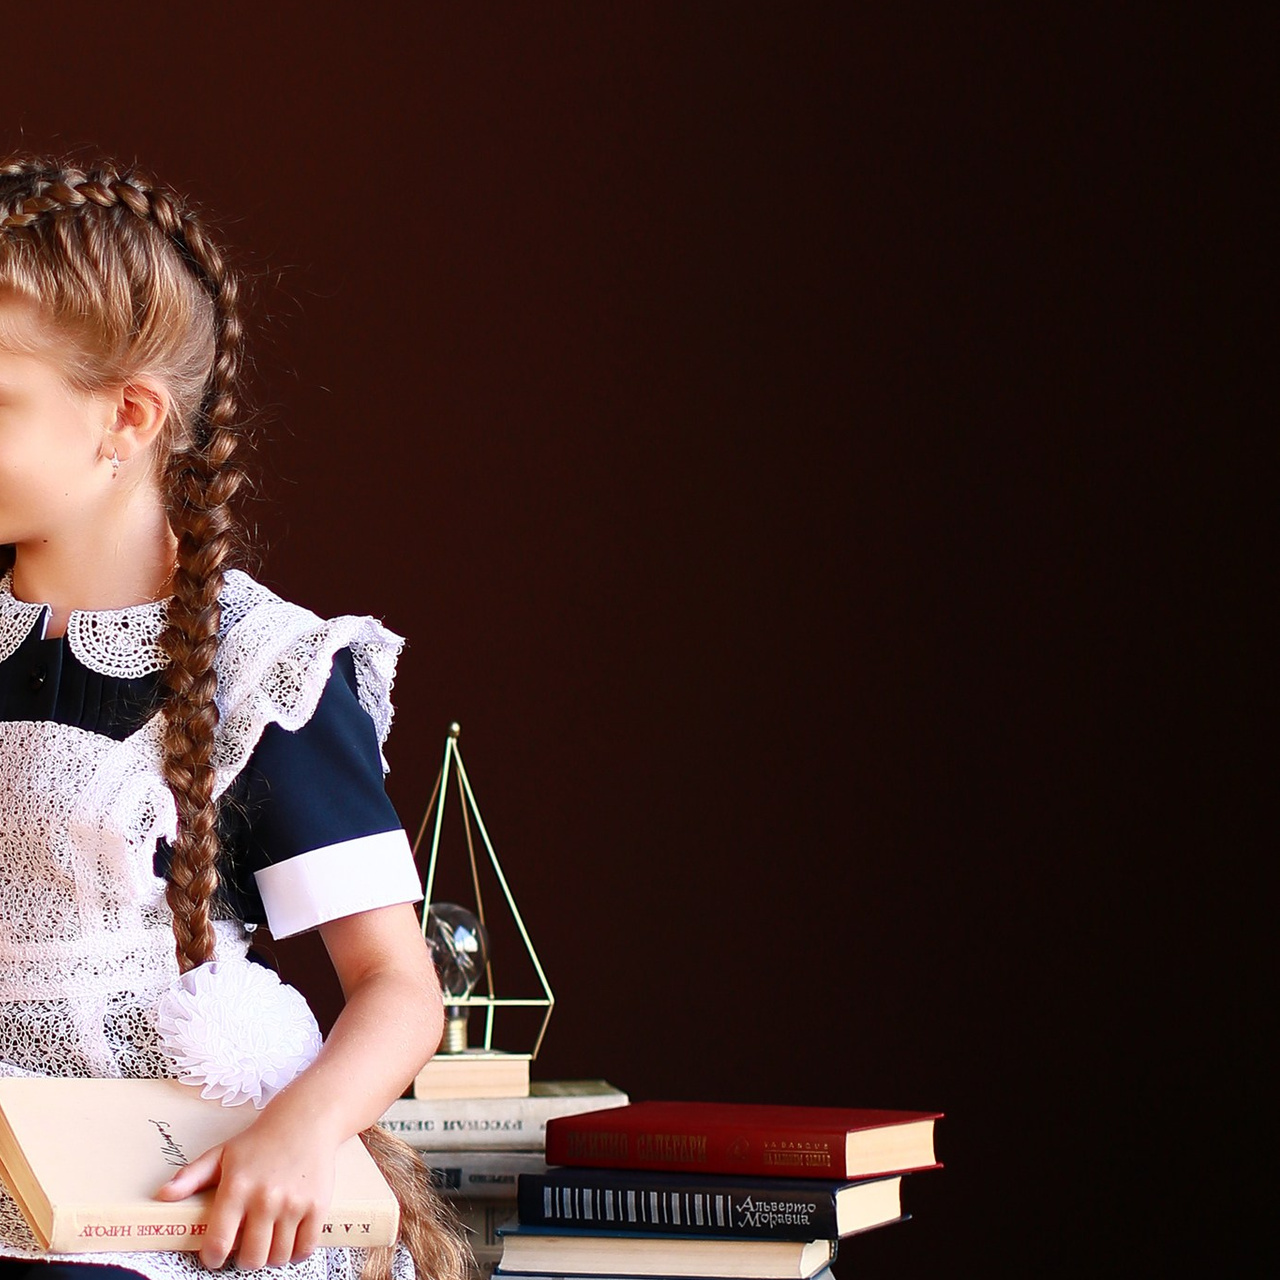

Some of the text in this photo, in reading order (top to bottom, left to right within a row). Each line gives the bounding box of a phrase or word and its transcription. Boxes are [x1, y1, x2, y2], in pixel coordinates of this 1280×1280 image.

[443, 1120, 524, 1131] РУССКАЯ
[637, 1133, 708, 1163] САЛЬГАРИ
[736, 1195, 817, 1214] Альберто
[737, 1211, 811, 1229] Моравиа
[77, 1223, 132, 1238] НАРОДУ
[137, 1224, 187, 1237] СЛУЖБЕ
[339, 1223, 353, 1234] А.
[356, 1223, 371, 1234] К.
